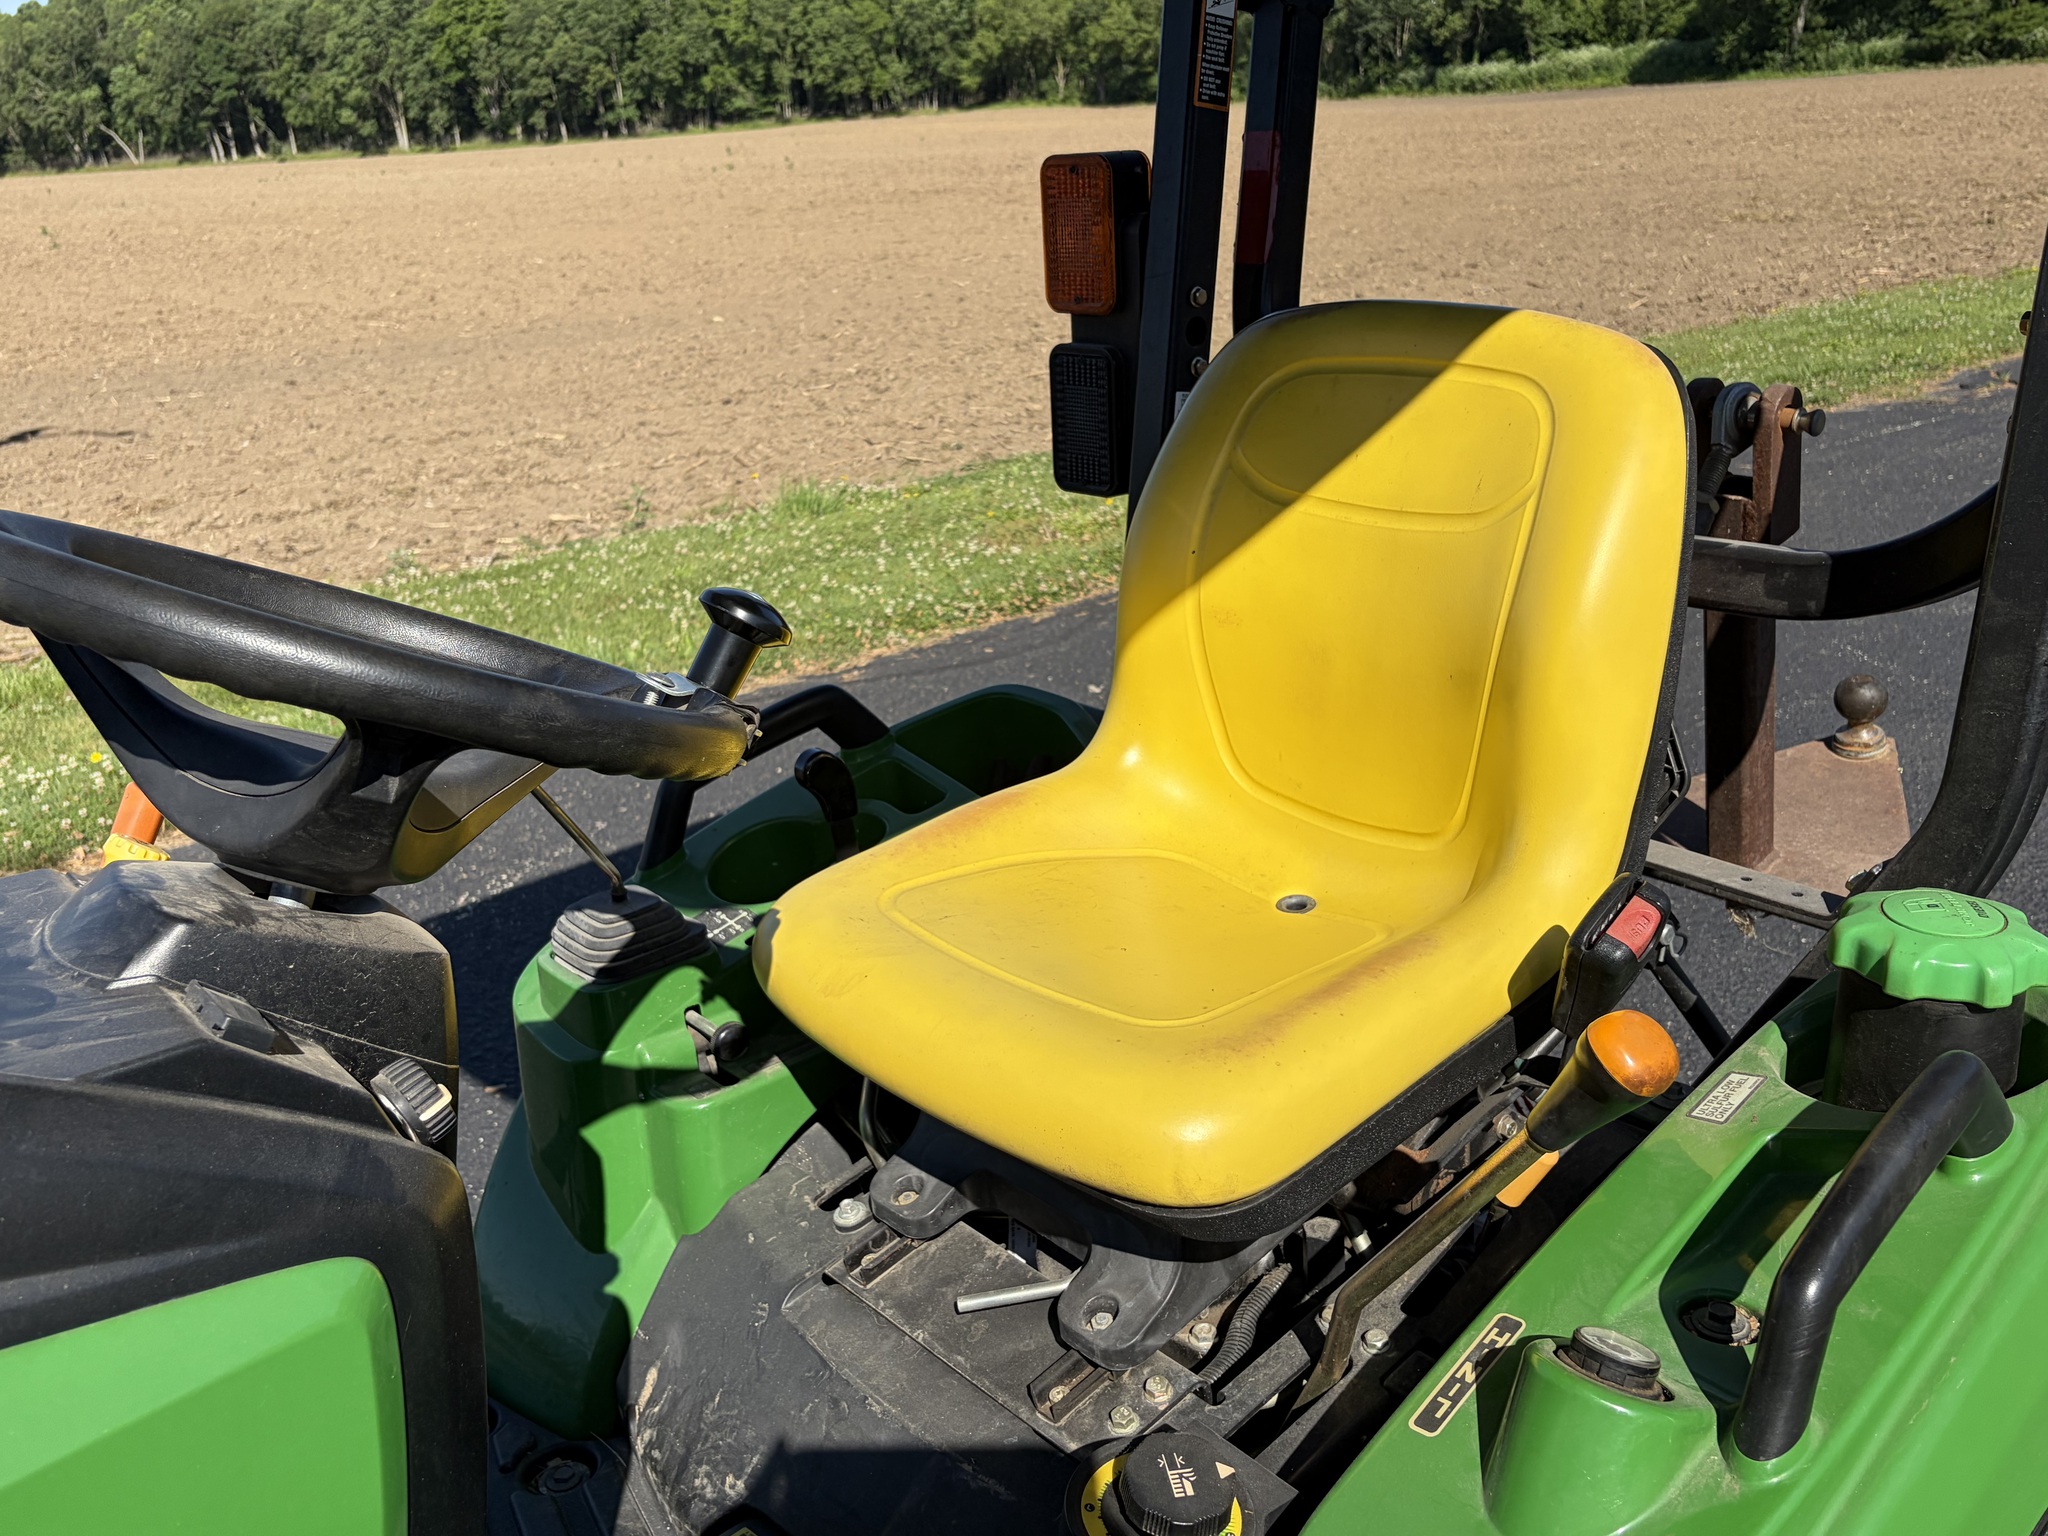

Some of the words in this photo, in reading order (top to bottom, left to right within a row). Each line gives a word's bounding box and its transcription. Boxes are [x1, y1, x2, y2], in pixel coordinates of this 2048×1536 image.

[1696, 1095, 1719, 1116] ULTRA
[1716, 1079, 1735, 1095] LOW
[1705, 1092, 1734, 1117] SULFUR
[1729, 1077, 1750, 1093] FUEL
[1715, 1102, 1735, 1119] ONLY
